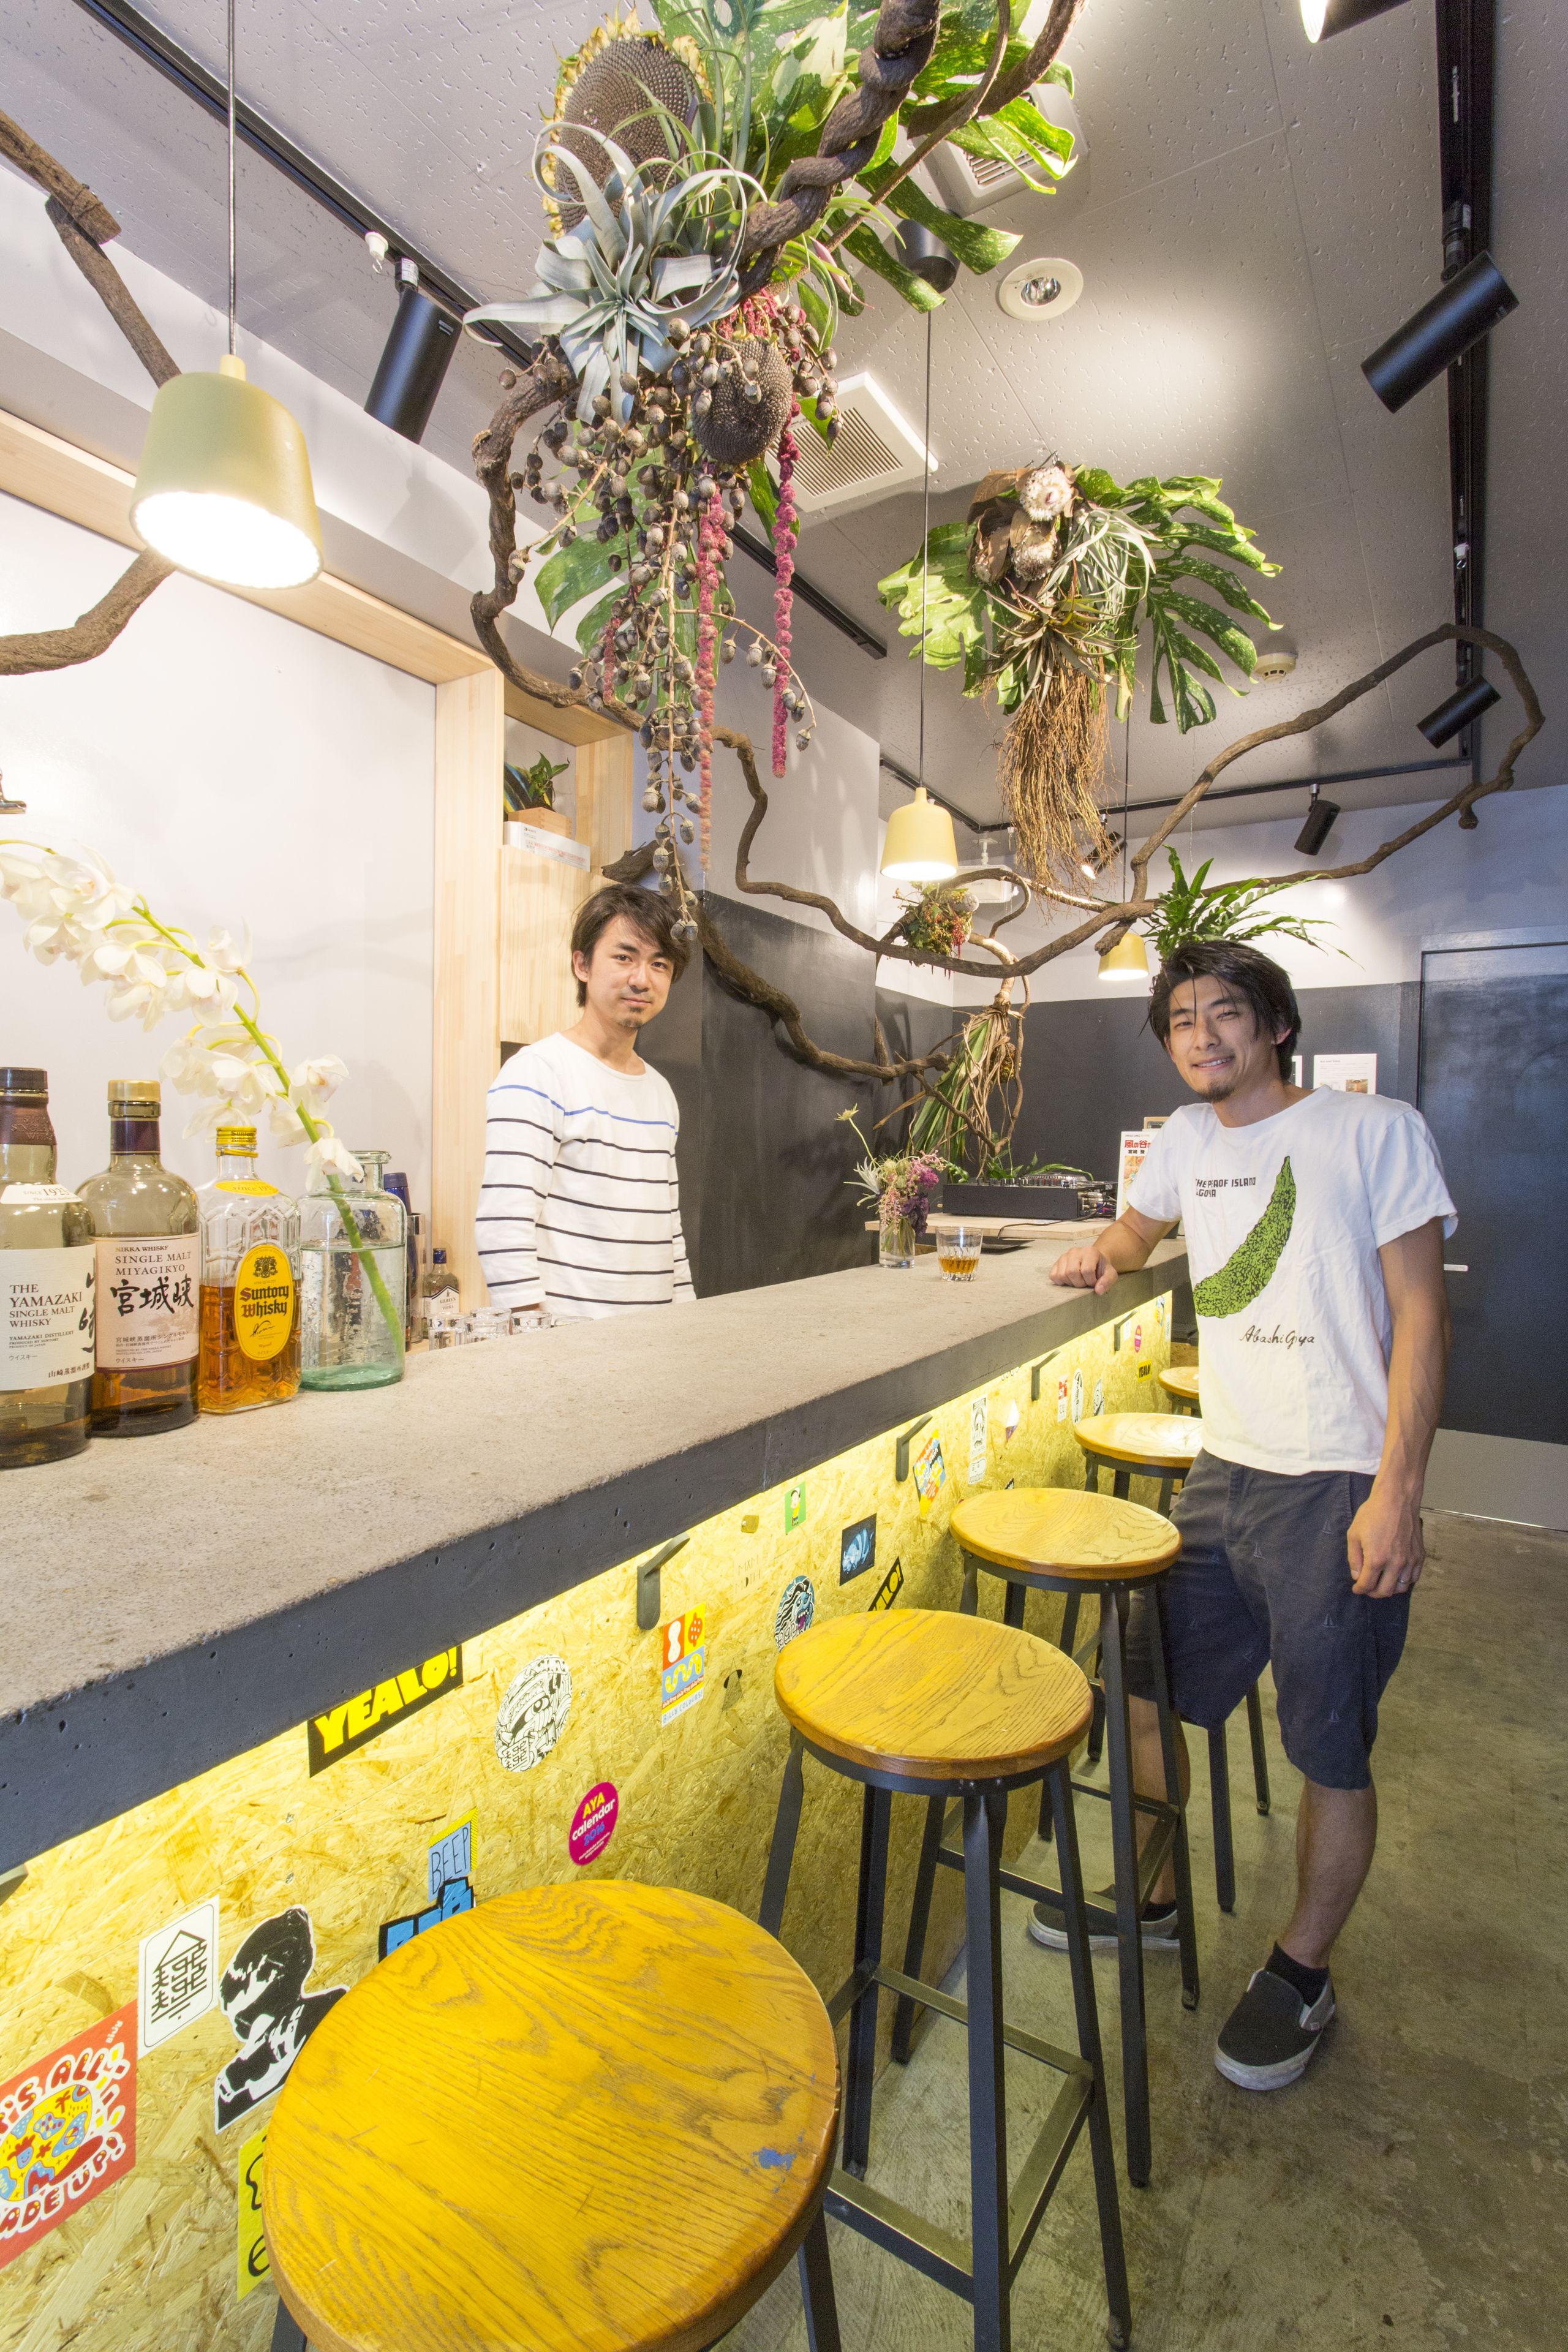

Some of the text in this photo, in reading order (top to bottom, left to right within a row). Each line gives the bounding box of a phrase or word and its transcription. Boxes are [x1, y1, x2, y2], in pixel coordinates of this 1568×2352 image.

[115, 1251, 191, 1264] SINGLE MALT
[115, 1264, 185, 1275] MIYAGIKYO
[9, 1284, 39, 1294] THE
[239, 1285, 289, 1302] Suntory
[9, 1292, 82, 1307] YAMAZAKI
[241, 1299, 287, 1319] Whisky
[9, 1306, 75, 1317] SINGLE MALT
[9, 1318, 51, 1327] WHISKY
[872, 1564, 902, 1610] ALO!
[314, 1646, 457, 1754] YEALO!
[582, 1792, 605, 1819] AYA
[572, 1799, 615, 1841] calendar
[584, 1822, 605, 1847] 2016
[431, 1826, 469, 1895] BEEP
[50, 2052, 105, 2089] ALL
